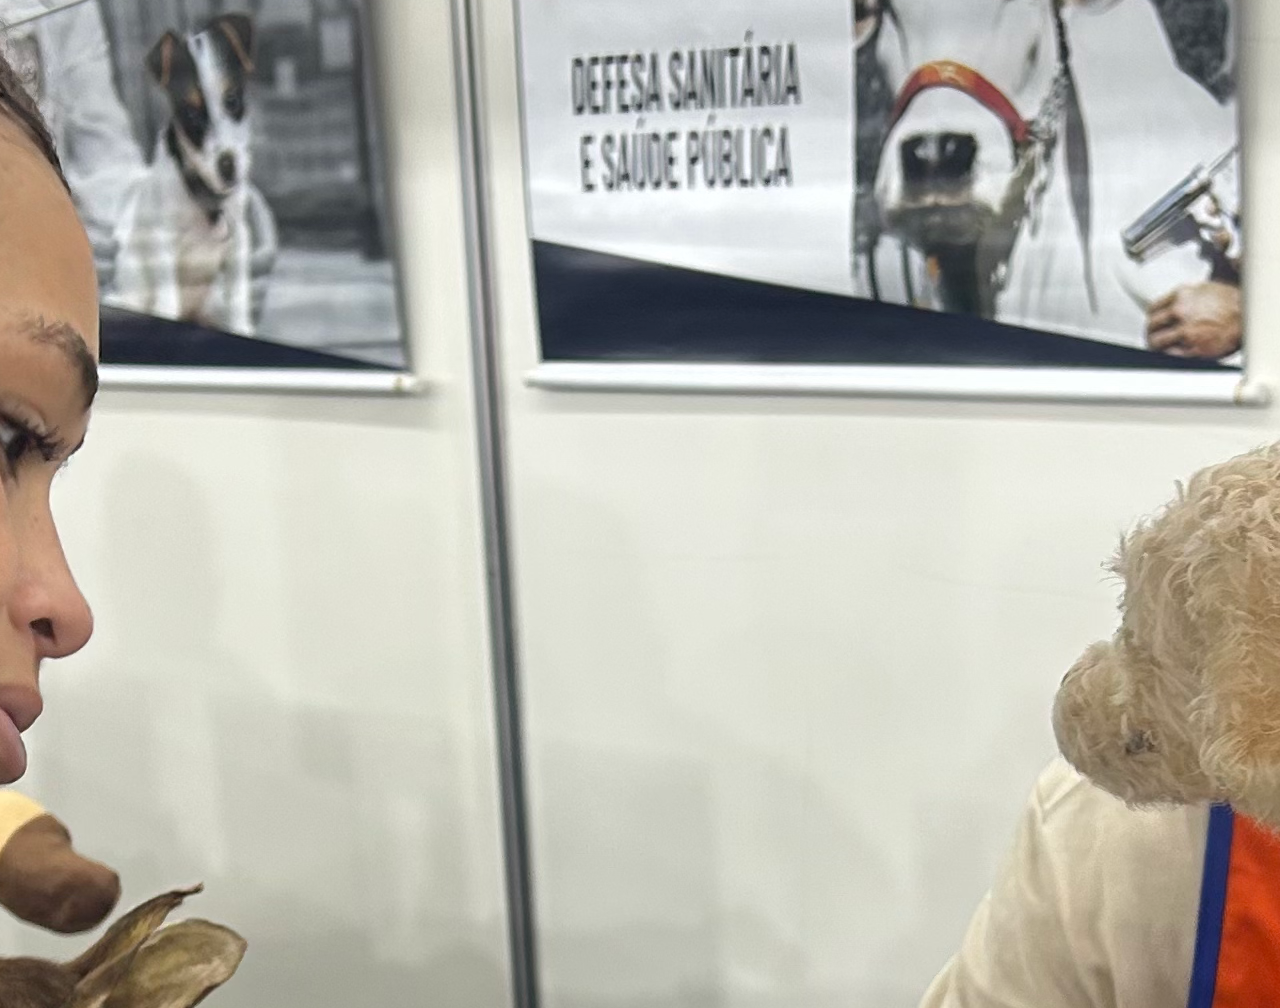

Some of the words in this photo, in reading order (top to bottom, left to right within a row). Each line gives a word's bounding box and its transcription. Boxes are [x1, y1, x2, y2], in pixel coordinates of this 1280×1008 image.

[572, 52, 665, 115] DEFESA
[668, 29, 802, 110] SANITÁRIA
[580, 134, 596, 193] E
[601, 116, 679, 191] SAÚDE
[686, 111, 794, 190] PÚBLICA
